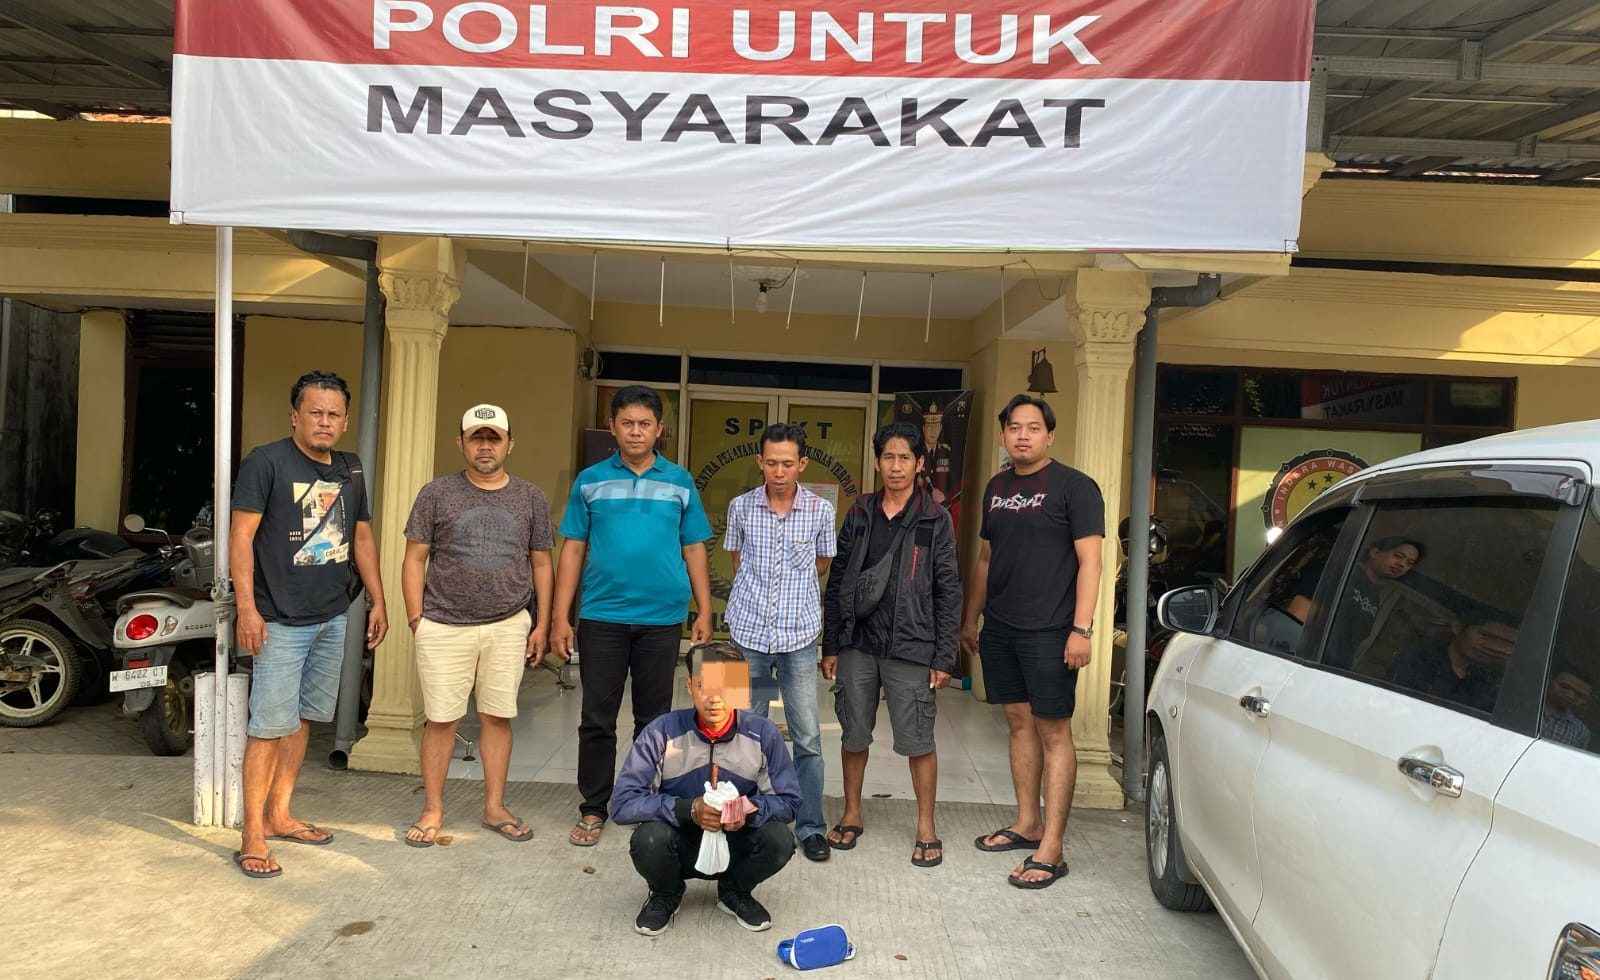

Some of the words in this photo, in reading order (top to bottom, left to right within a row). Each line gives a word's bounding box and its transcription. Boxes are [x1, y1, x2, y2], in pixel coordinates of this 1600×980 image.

[373, 0, 690, 59] POLRI
[732, 8, 1102, 66] UNTUK
[366, 84, 1105, 149] MASYARAKAT
